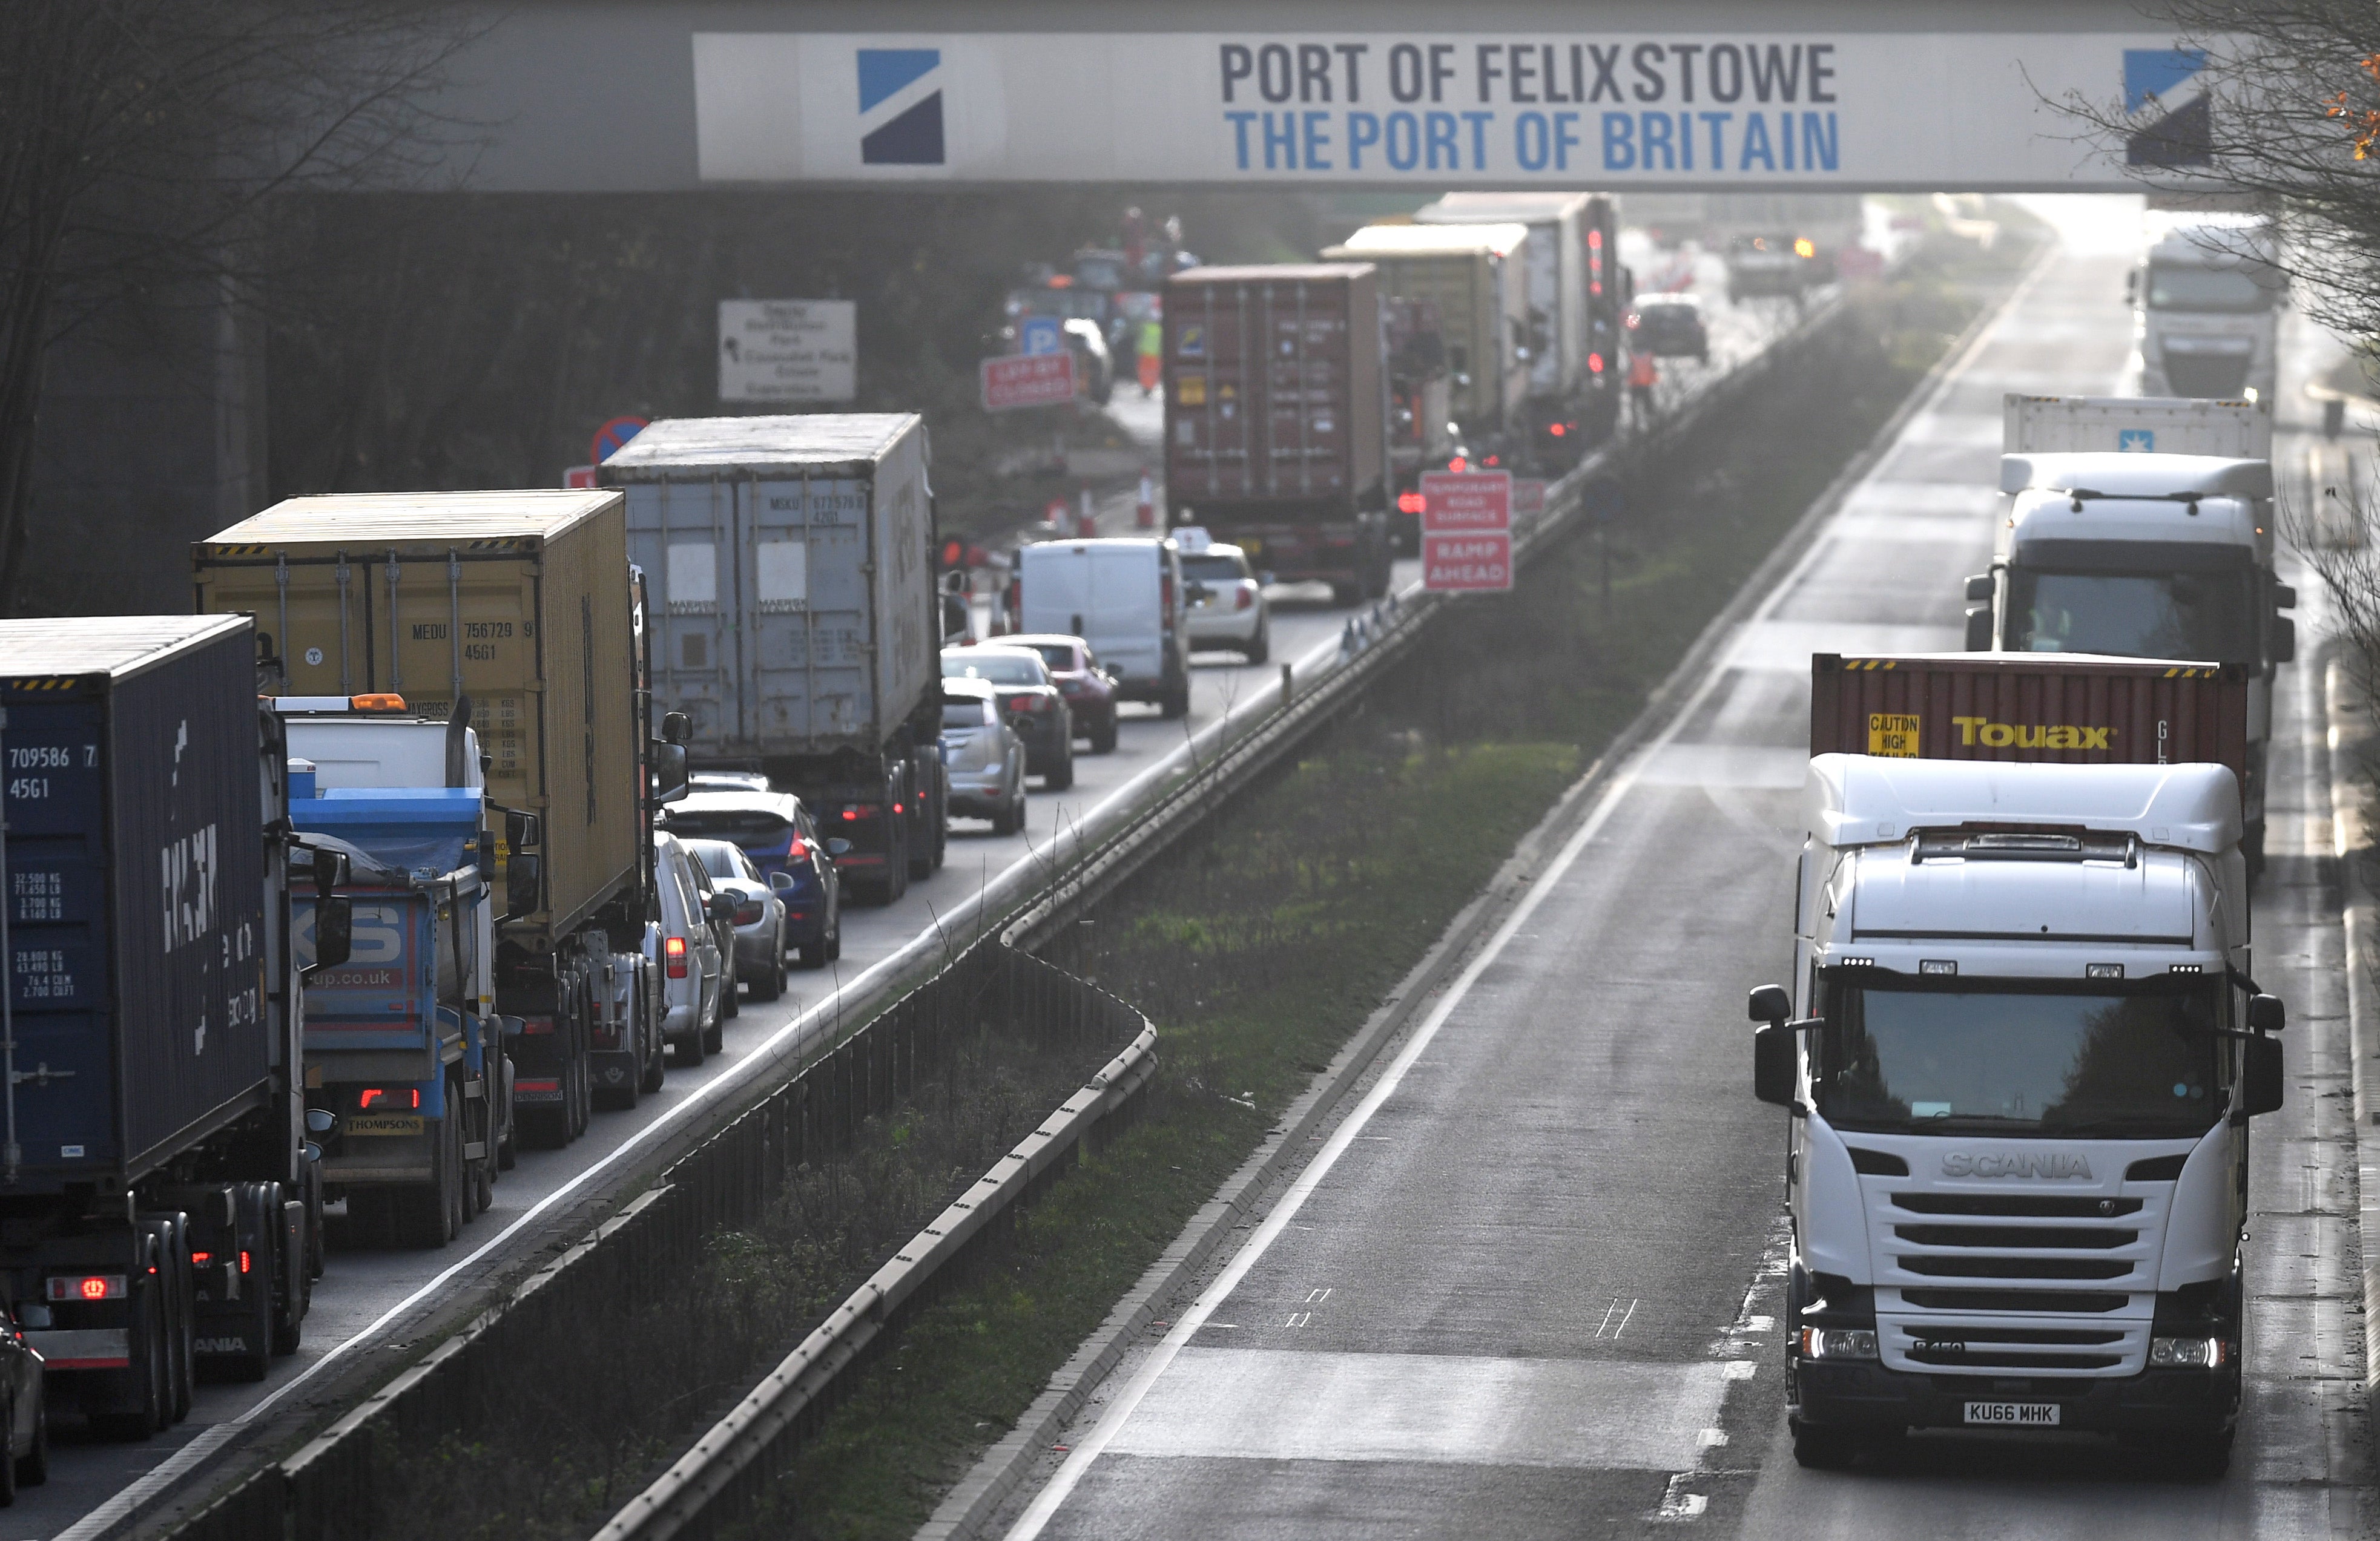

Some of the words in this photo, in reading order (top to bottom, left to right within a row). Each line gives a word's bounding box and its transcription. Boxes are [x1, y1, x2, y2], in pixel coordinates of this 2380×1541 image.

[1219, 43, 1368, 104] PORT
[1389, 43, 1457, 104] OF
[1477, 43, 1837, 104] FELIXSTOWE
[1224, 111, 1332, 172] THE
[1347, 111, 1495, 172] PORT
[1515, 111, 1581, 172] OF
[1602, 111, 1839, 172] BRITAIN
[1437, 542, 1500, 559] RAMP
[1430, 564, 1506, 582] AHEAD
[413, 623, 446, 640] MEDU
[464, 622, 512, 639] 756729
[501, 699, 514, 708] KGS
[1870, 715, 1917, 732] CAUTION
[1882, 734, 1906, 749] HIGH
[10, 746, 70, 768] 709586
[85, 746, 96, 767] 7
[10, 778, 48, 798] 45G1
[50, 884, 61, 895] LB
[50, 908, 62, 919] LB
[348, 1119, 420, 1132] THOMPSONS
[1941, 1151, 2093, 1180] SCANIA
[193, 1337, 247, 1352] ANIA
[1970, 1404, 2015, 1421] KU66
[2019, 1405, 2053, 1422] MHK
